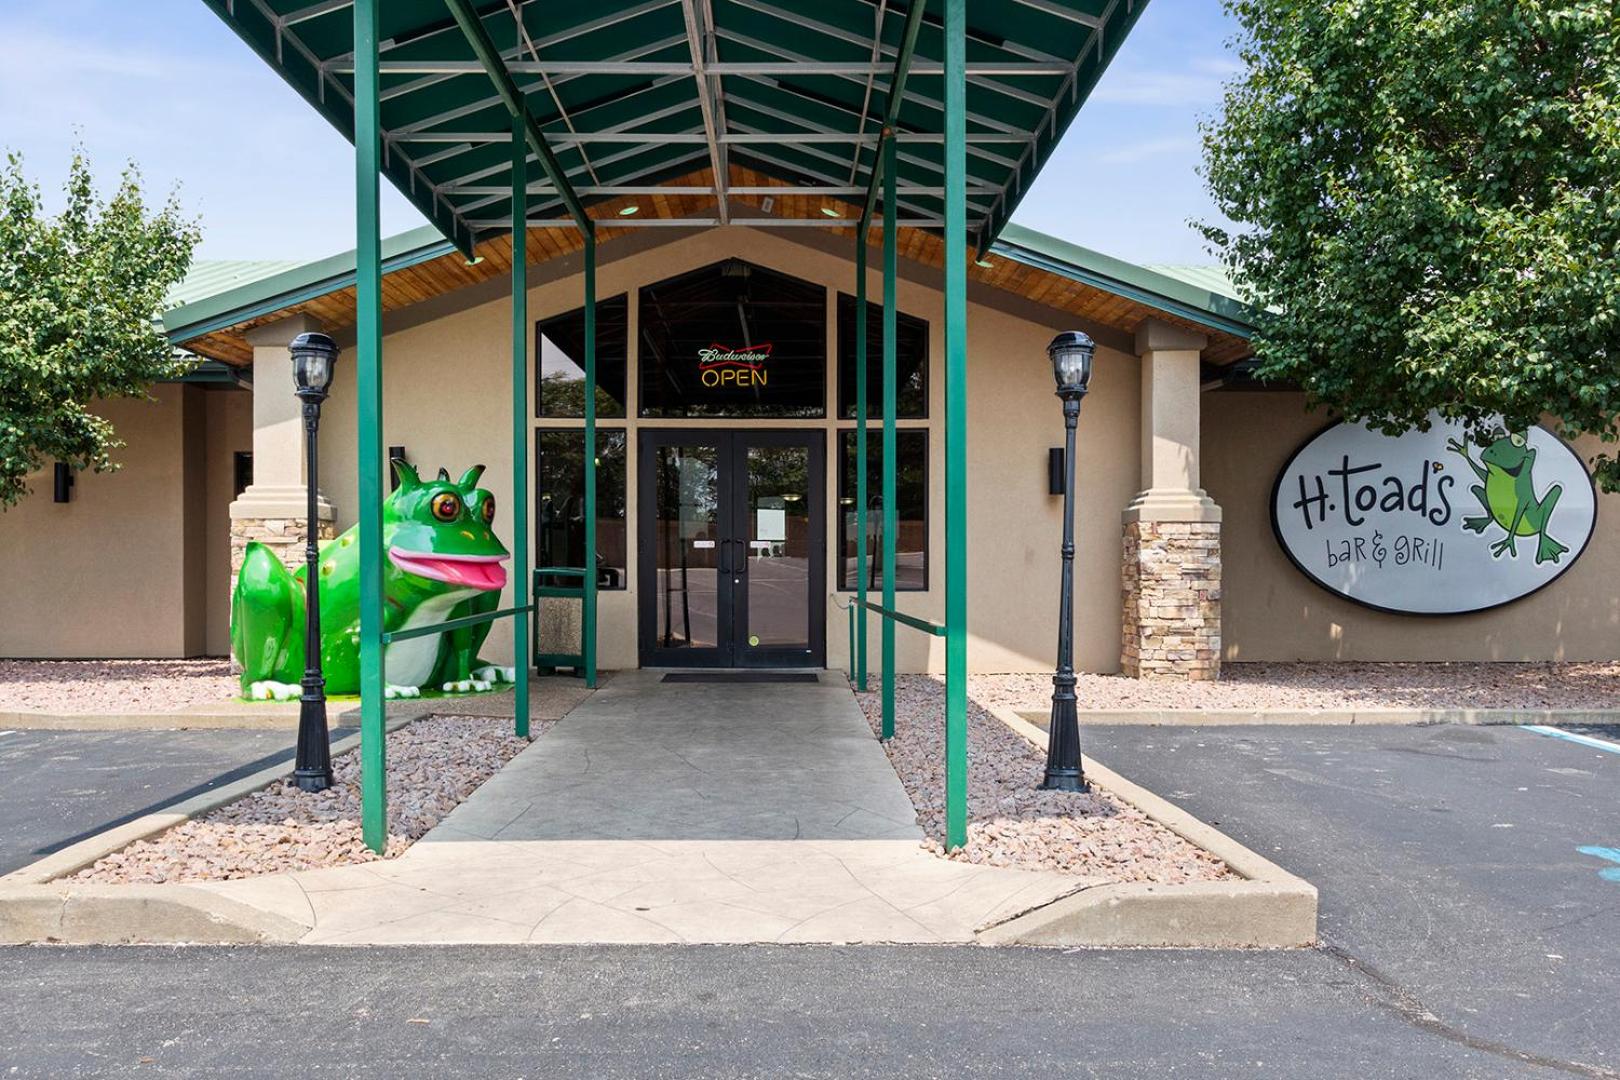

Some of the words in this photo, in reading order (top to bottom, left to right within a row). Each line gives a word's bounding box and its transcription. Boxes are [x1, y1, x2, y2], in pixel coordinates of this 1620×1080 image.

[698, 349, 769, 362] Budweiser
[702, 369, 767, 387] OPEN
[1372, 529, 1387, 568] &
